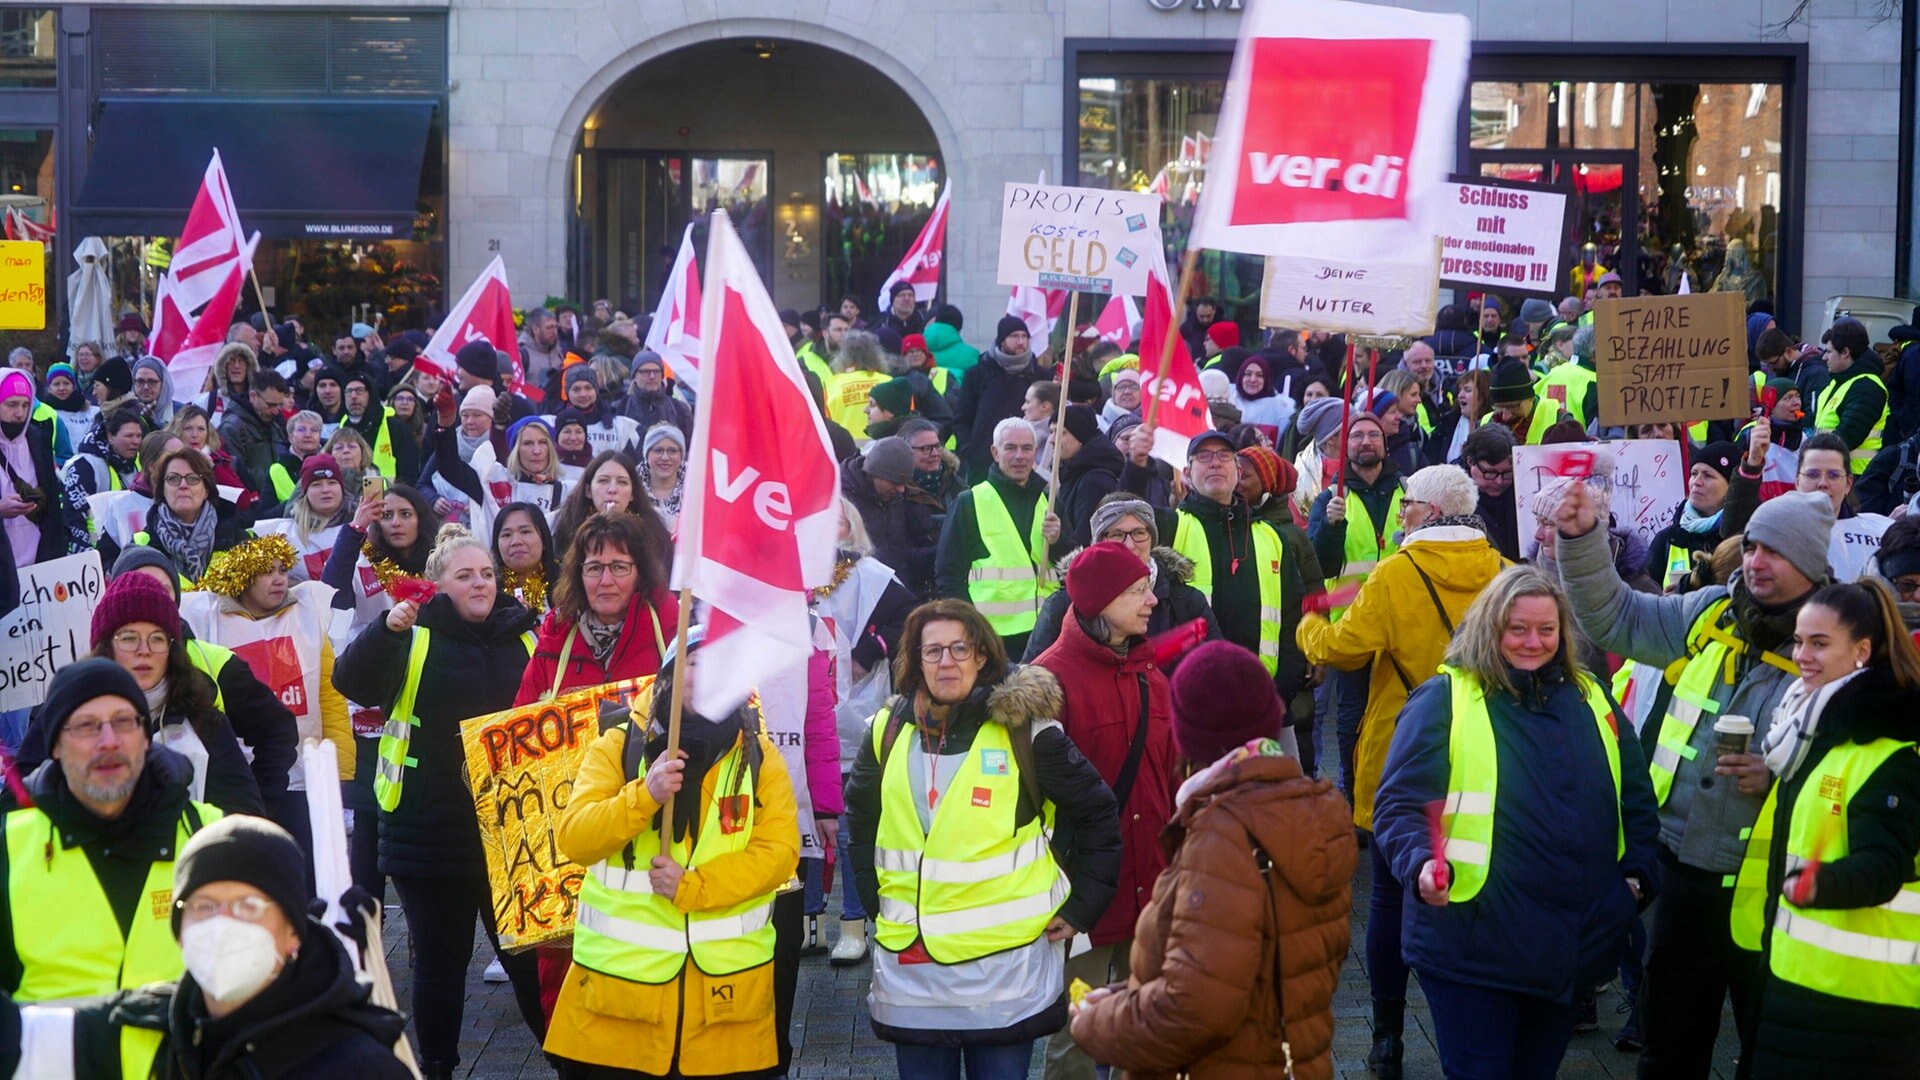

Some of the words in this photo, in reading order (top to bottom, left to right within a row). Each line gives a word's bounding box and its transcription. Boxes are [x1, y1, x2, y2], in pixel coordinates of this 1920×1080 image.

[1248, 152, 1404, 199] ver.di
[1010, 187, 1126, 216] PROFIS
[1459, 186, 1529, 209] Schluss
[305, 224, 393, 234] WWW.BLUME2000.DE
[1030, 219, 1100, 239] kosten
[1476, 216, 1506, 234] mit
[488, 239, 500, 251] 21
[1023, 230, 1107, 272] GELD
[1443, 236, 1463, 248] der
[1464, 239, 1535, 256] emotionalen
[5, 257, 32, 266] man
[1314, 266, 1368, 280] DEINE
[1299, 295, 1376, 316] MUTTER
[1619, 306, 1690, 333] FAIRE
[1608, 336, 1731, 362] BEZAHLUNG
[1632, 363, 1686, 385] STATT
[1620, 377, 1730, 416] PROFITE!
[9, 618, 43, 638] ein
